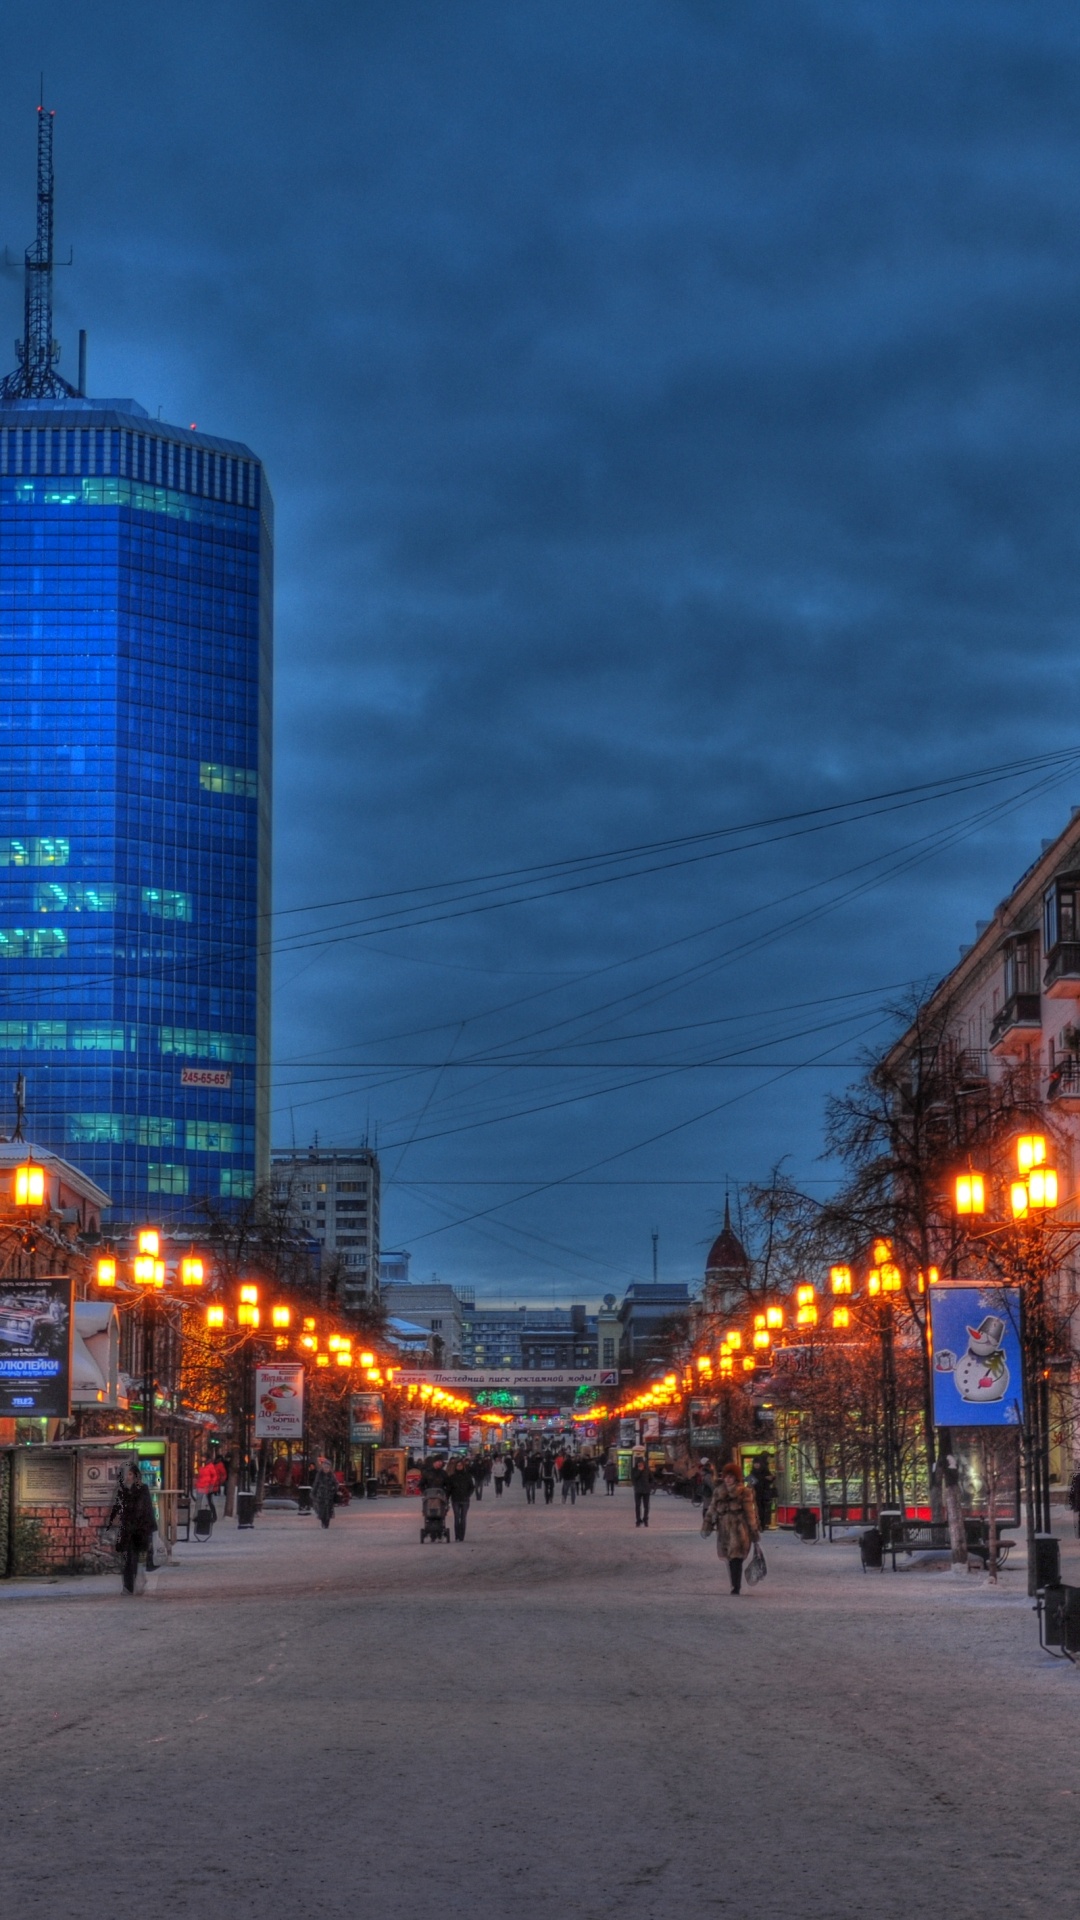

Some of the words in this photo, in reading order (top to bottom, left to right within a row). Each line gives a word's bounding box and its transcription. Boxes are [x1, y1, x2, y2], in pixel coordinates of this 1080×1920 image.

[182, 1071, 225, 1084] 245-65-65
[434, 1373, 485, 1383] Последний
[514, 1374, 564, 1385] рекламной
[567, 1373, 597, 1383] моды!
[12, 1397, 34, 1405] TELE2
